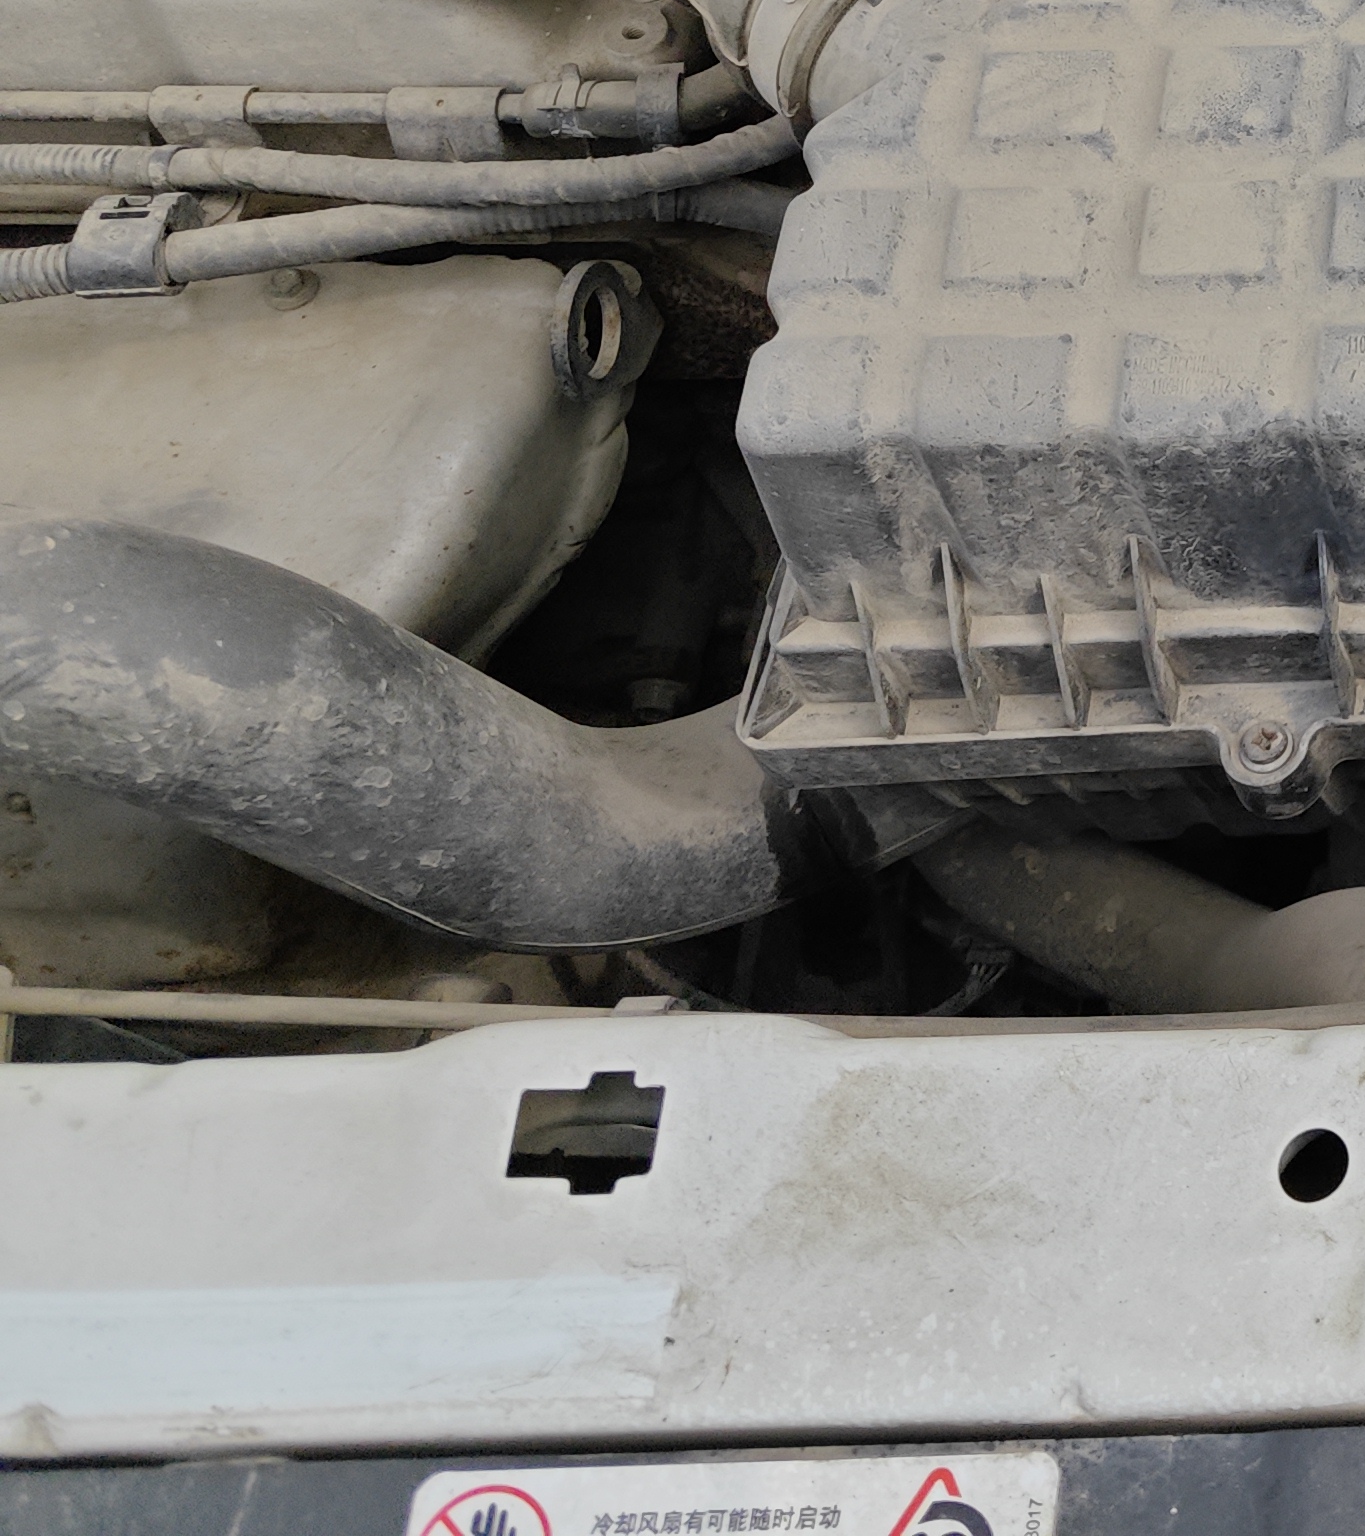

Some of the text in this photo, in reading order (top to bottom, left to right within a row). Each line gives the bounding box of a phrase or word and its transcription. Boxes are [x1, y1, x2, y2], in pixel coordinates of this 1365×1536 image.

[590, 1504, 842, 1536] 冷却风扇有可能随时启动
